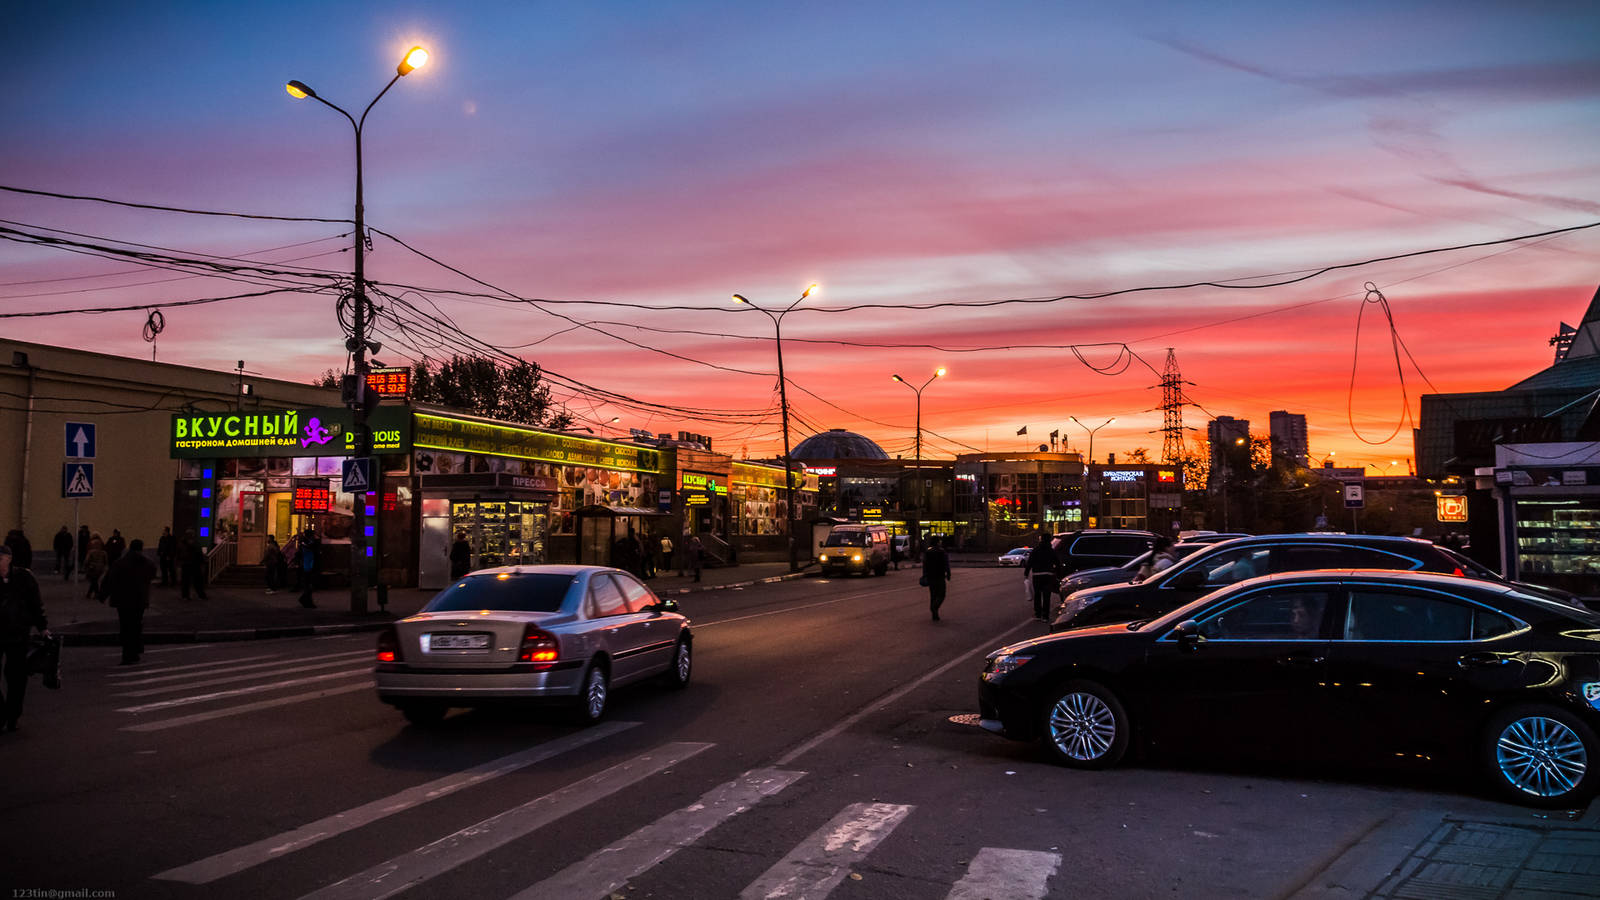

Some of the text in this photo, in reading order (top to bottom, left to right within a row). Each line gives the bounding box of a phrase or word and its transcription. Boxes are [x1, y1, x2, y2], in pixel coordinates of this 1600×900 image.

[176, 410, 298, 438] ВКУСНЫЙ
[175, 437, 297, 449] гастроном домашней еды
[345, 431, 400, 443] DIOUS
[512, 477, 546, 488] ПРЕССА
